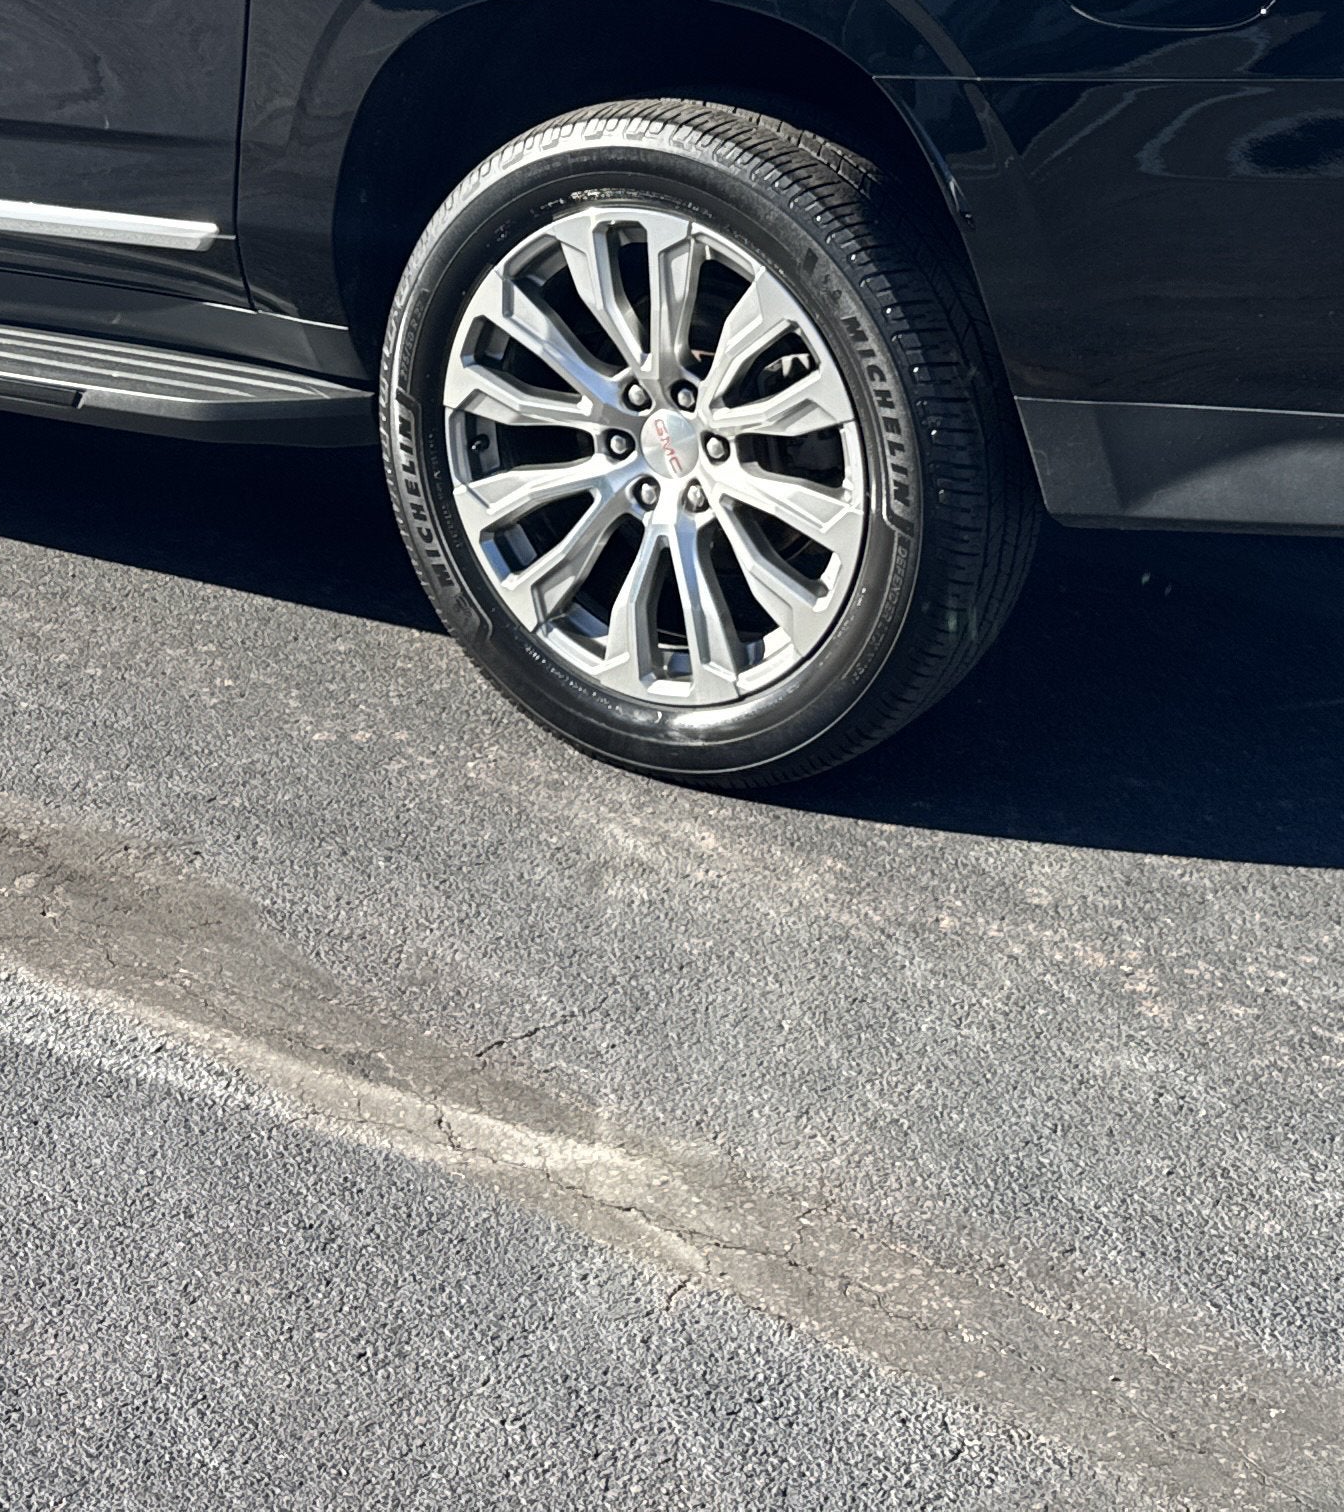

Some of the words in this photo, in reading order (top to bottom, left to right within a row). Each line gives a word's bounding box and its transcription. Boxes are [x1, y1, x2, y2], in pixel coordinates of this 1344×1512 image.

[654, 419, 683, 474] GMC
[841, 316, 910, 507] MICHELIN
[398, 415, 455, 588] MICHELIN
[882, 544, 907, 623] DEFENDER
